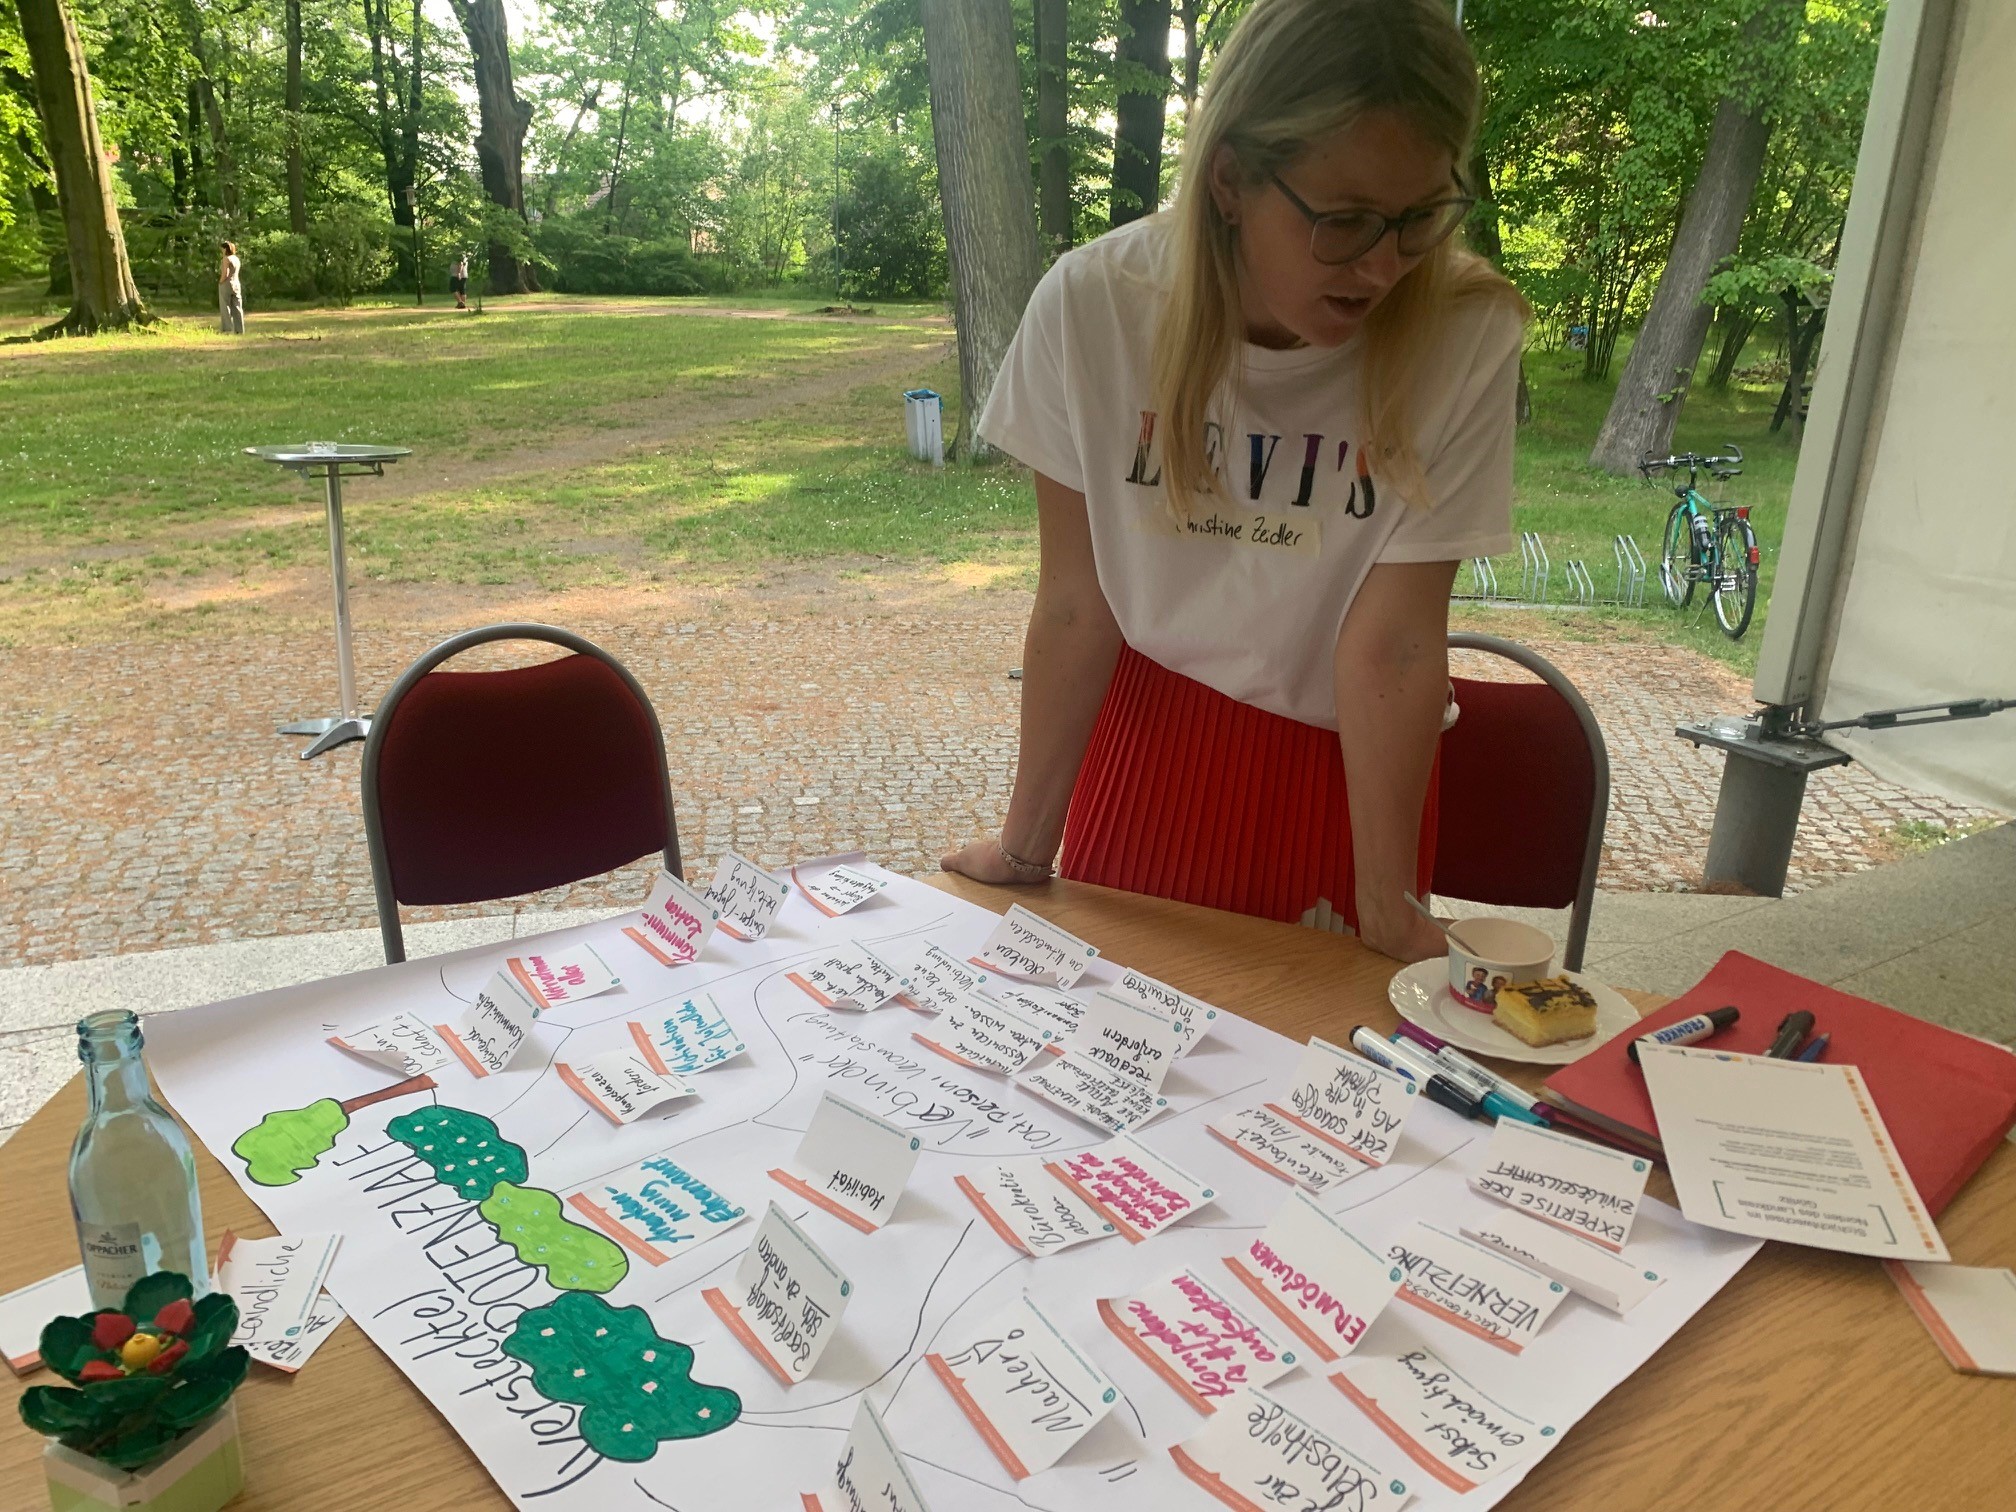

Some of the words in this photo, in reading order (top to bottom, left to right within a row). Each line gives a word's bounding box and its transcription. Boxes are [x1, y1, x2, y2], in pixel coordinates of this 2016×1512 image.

[923, 946, 975, 989] Verbindung
[1068, 958, 1084, 972] an
[936, 986, 958, 1004] aber
[1324, 1081, 1351, 1106] die
[1335, 1065, 1382, 1104] Pflicht
[1291, 1082, 1349, 1135] schaffen
[1352, 1092, 1367, 1119] in
[1371, 1107, 1402, 1134] AG
[1346, 1128, 1388, 1159] Zeit
[1236, 1129, 1334, 1190] Vereinbarkeit
[1479, 1177, 1515, 1199] DER
[1777, 1195, 1818, 1208] Görlitz
[1519, 1192, 1626, 1243] EXPERTISE
[1798, 1208, 1819, 1218] des
[1822, 1211, 1868, 1226] Norden
[1249, 1239, 1367, 1345] ERMÖGLICHEN
[1387, 1245, 1540, 1332] VERNETZUNG
[1397, 1351, 1529, 1447] ermächtigung
[1247, 1402, 1378, 1512] Selbsthilfe
